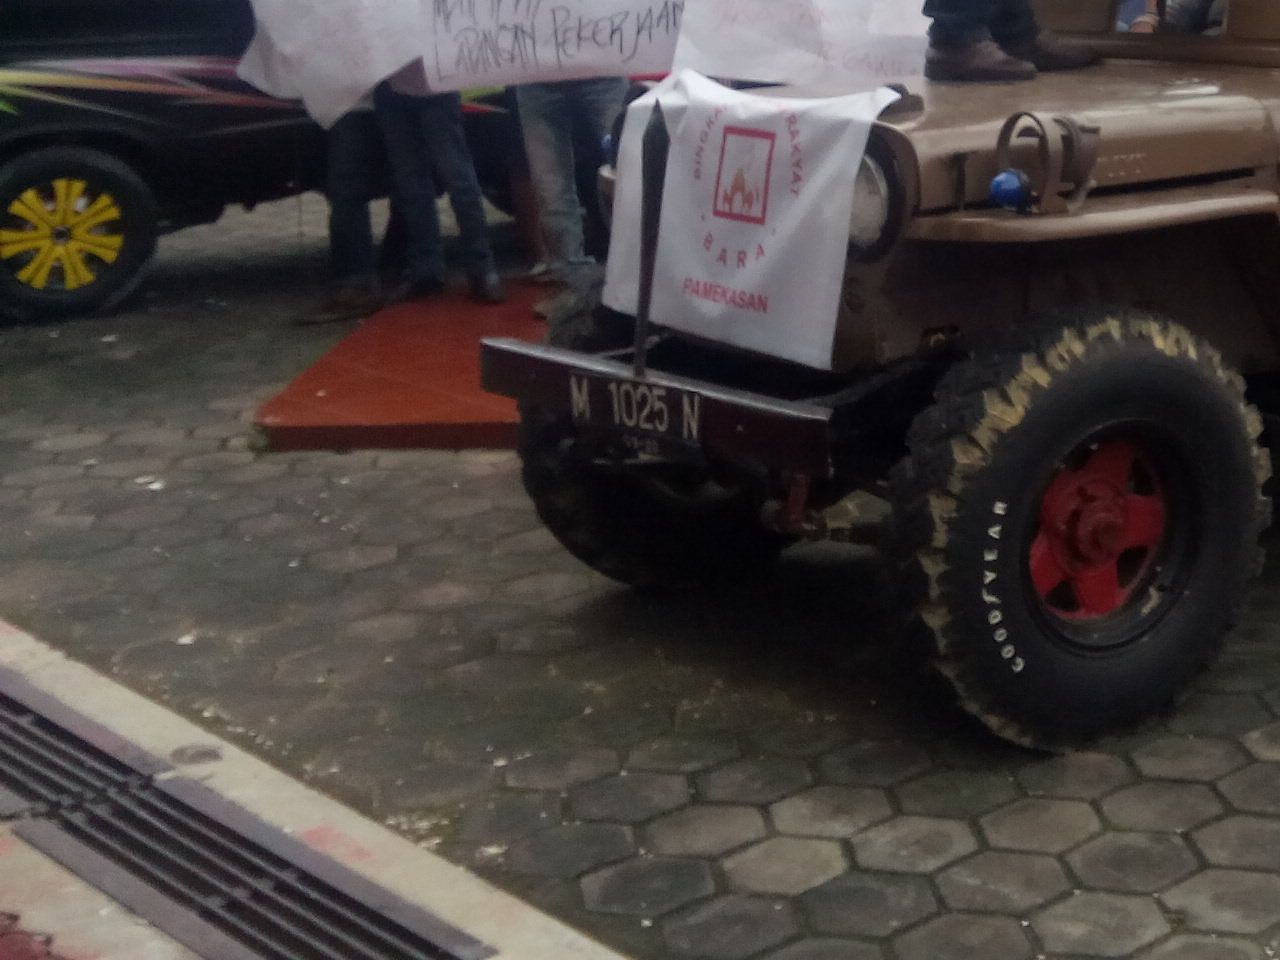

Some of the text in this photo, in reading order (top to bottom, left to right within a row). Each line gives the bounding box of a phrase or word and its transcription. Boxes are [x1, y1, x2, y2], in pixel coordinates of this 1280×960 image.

[703, 231, 766, 270] BARA
[682, 276, 769, 314] PAMEKASAN
[569, 375, 699, 440] M 1025 N
